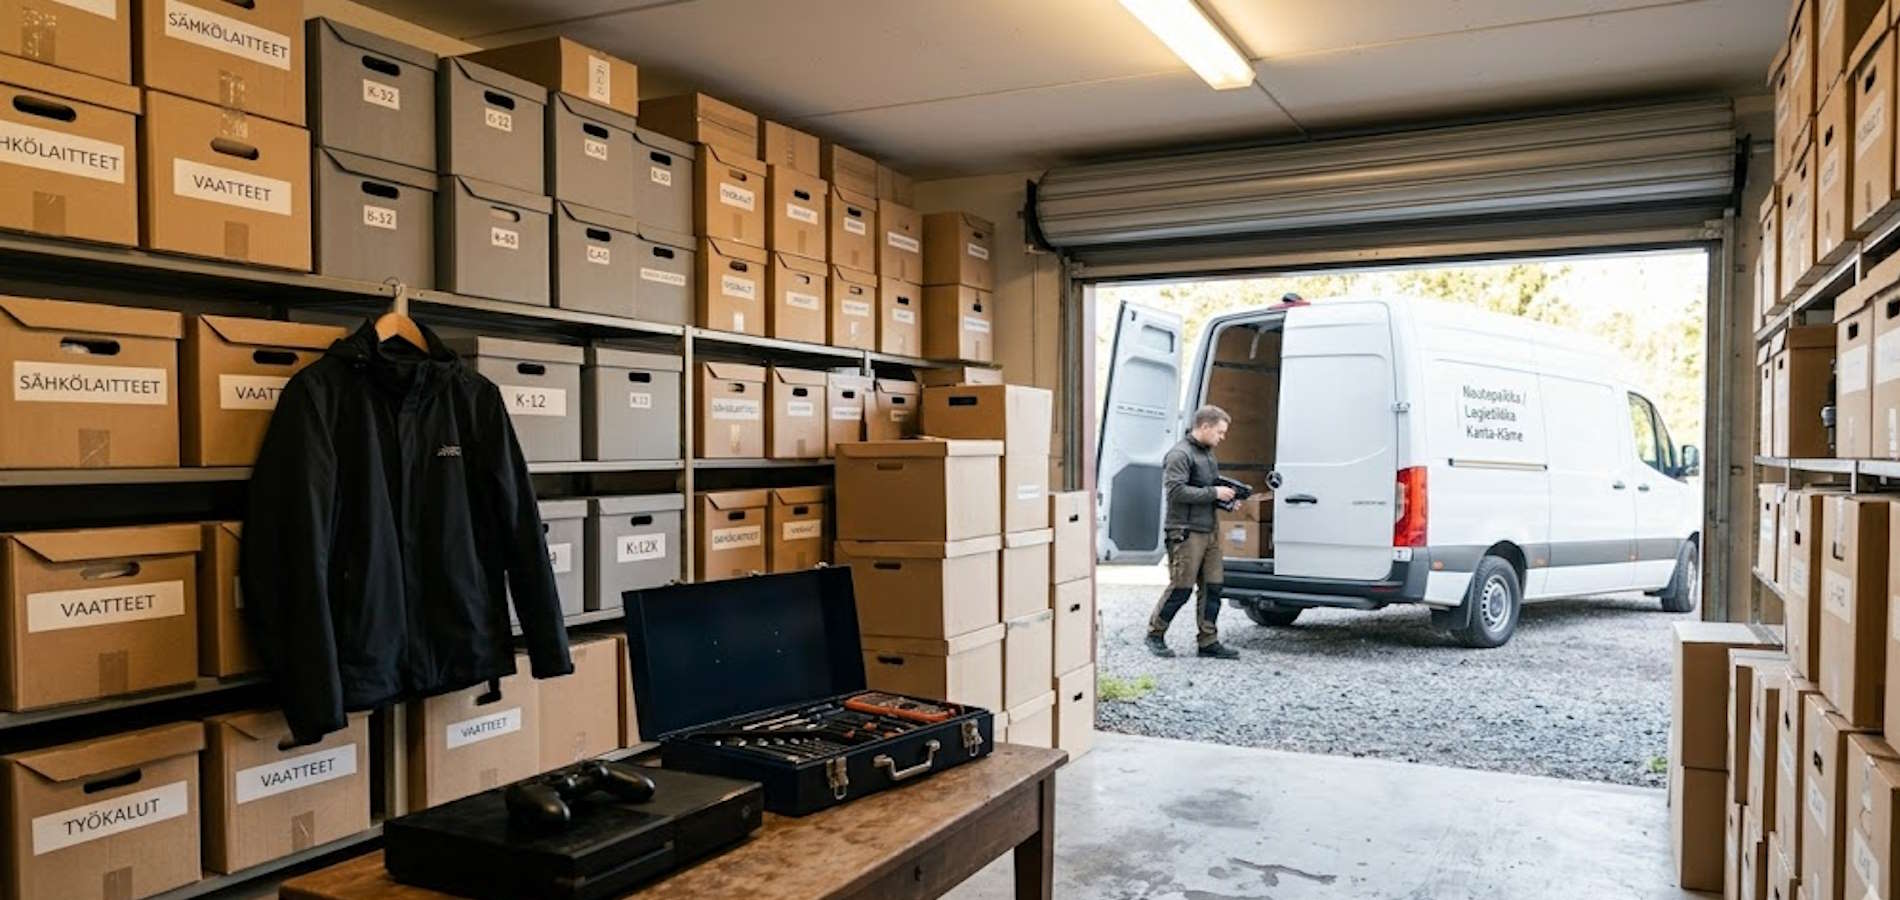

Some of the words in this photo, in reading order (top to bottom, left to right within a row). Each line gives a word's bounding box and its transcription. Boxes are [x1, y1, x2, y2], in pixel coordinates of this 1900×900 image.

[193, 174, 272, 202] VAATTEET
[19, 372, 161, 395] SÄHKÖLAITTEET
[515, 393, 546, 408] K-12
[60, 594, 156, 618] VAATTEET
[460, 717, 507, 738] VAATTEET
[260, 757, 336, 788] VAATTEET
[63, 798, 161, 836] TYÖKALUT
